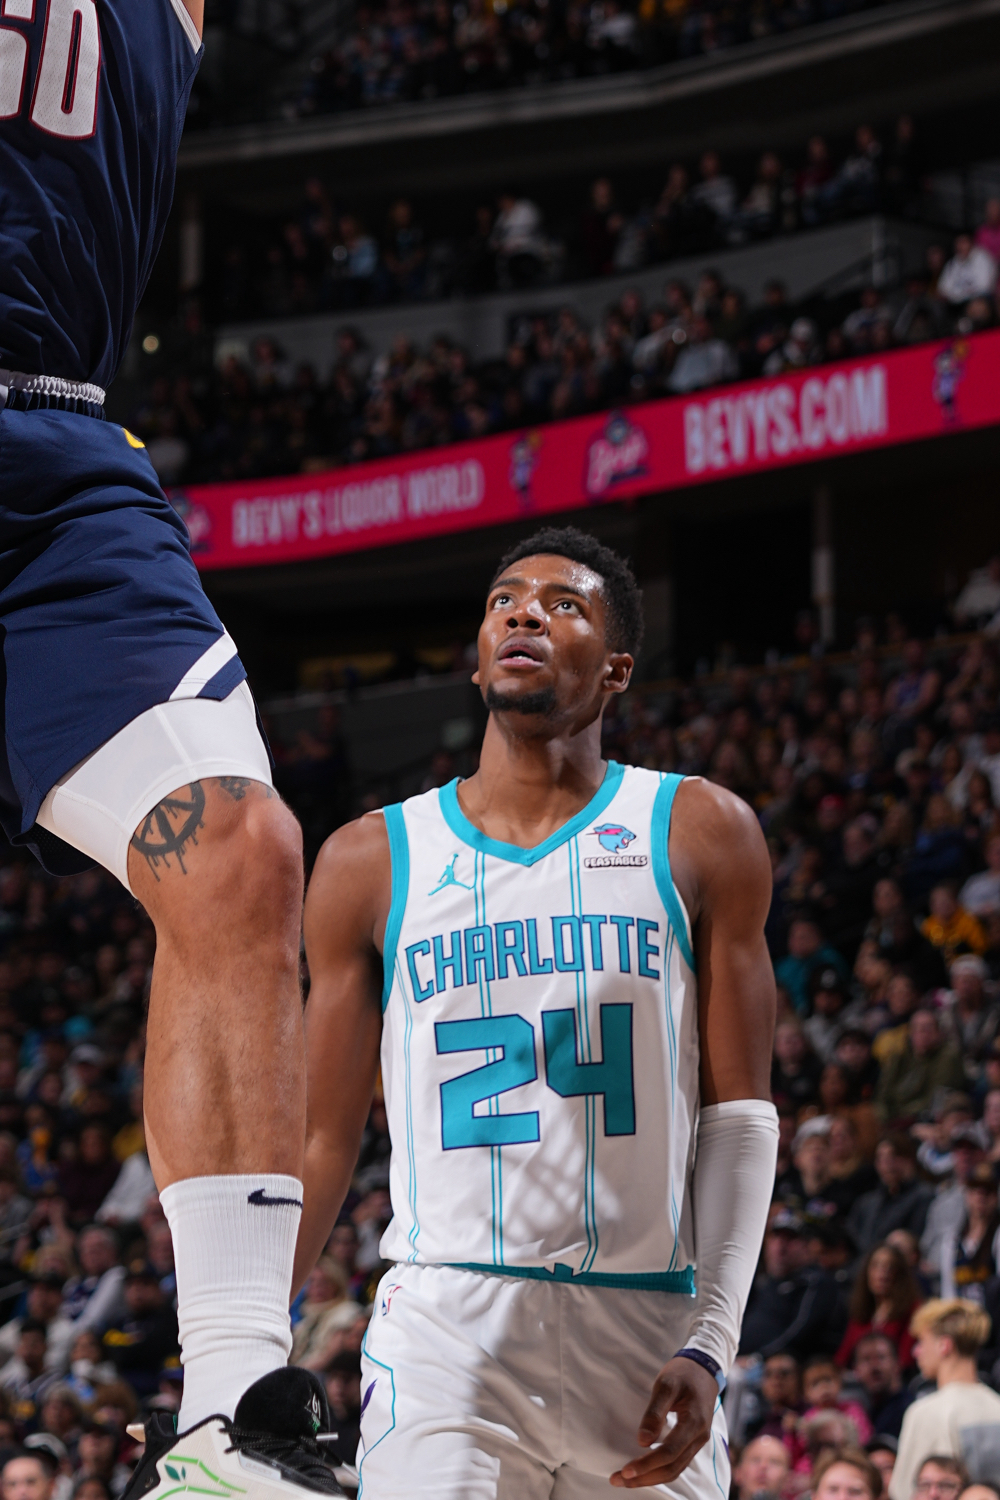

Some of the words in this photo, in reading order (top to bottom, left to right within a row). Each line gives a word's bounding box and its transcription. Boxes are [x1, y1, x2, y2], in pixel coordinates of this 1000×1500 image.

[683, 364, 890, 475] BEVYS.COM
[406, 458, 486, 520] WORLD
[584, 855, 648, 868] FEASTABLES
[405, 914, 660, 1004] CHARLOTTE
[434, 1003, 636, 1151] 24
